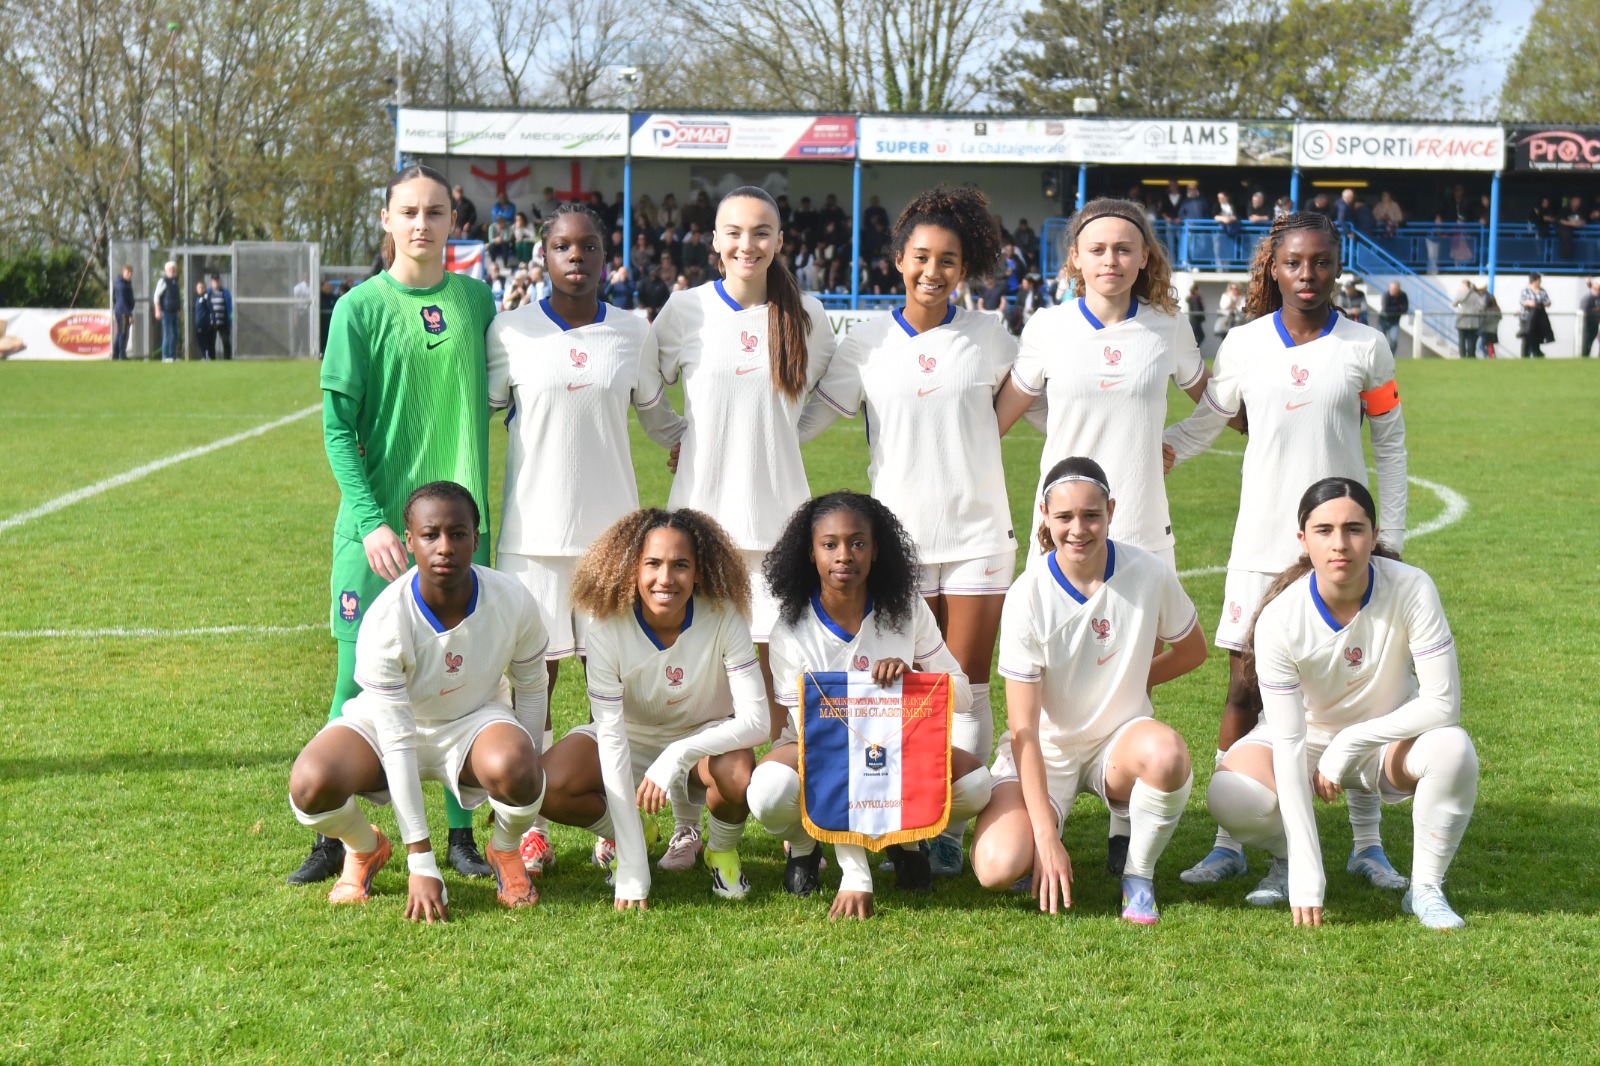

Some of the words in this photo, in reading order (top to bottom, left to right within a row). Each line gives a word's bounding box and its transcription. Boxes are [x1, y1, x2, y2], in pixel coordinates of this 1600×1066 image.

[653, 120, 729, 150] DOMAPI
[1169, 125, 1229, 145] LAMS
[876, 141, 929, 153] SUPER
[961, 142, 975, 153] La
[819, 708, 852, 718] MATCH
[854, 708, 867, 718] DE
[868, 708, 933, 718] CLASSEMENT
[855, 799, 883, 809] AVRIL
